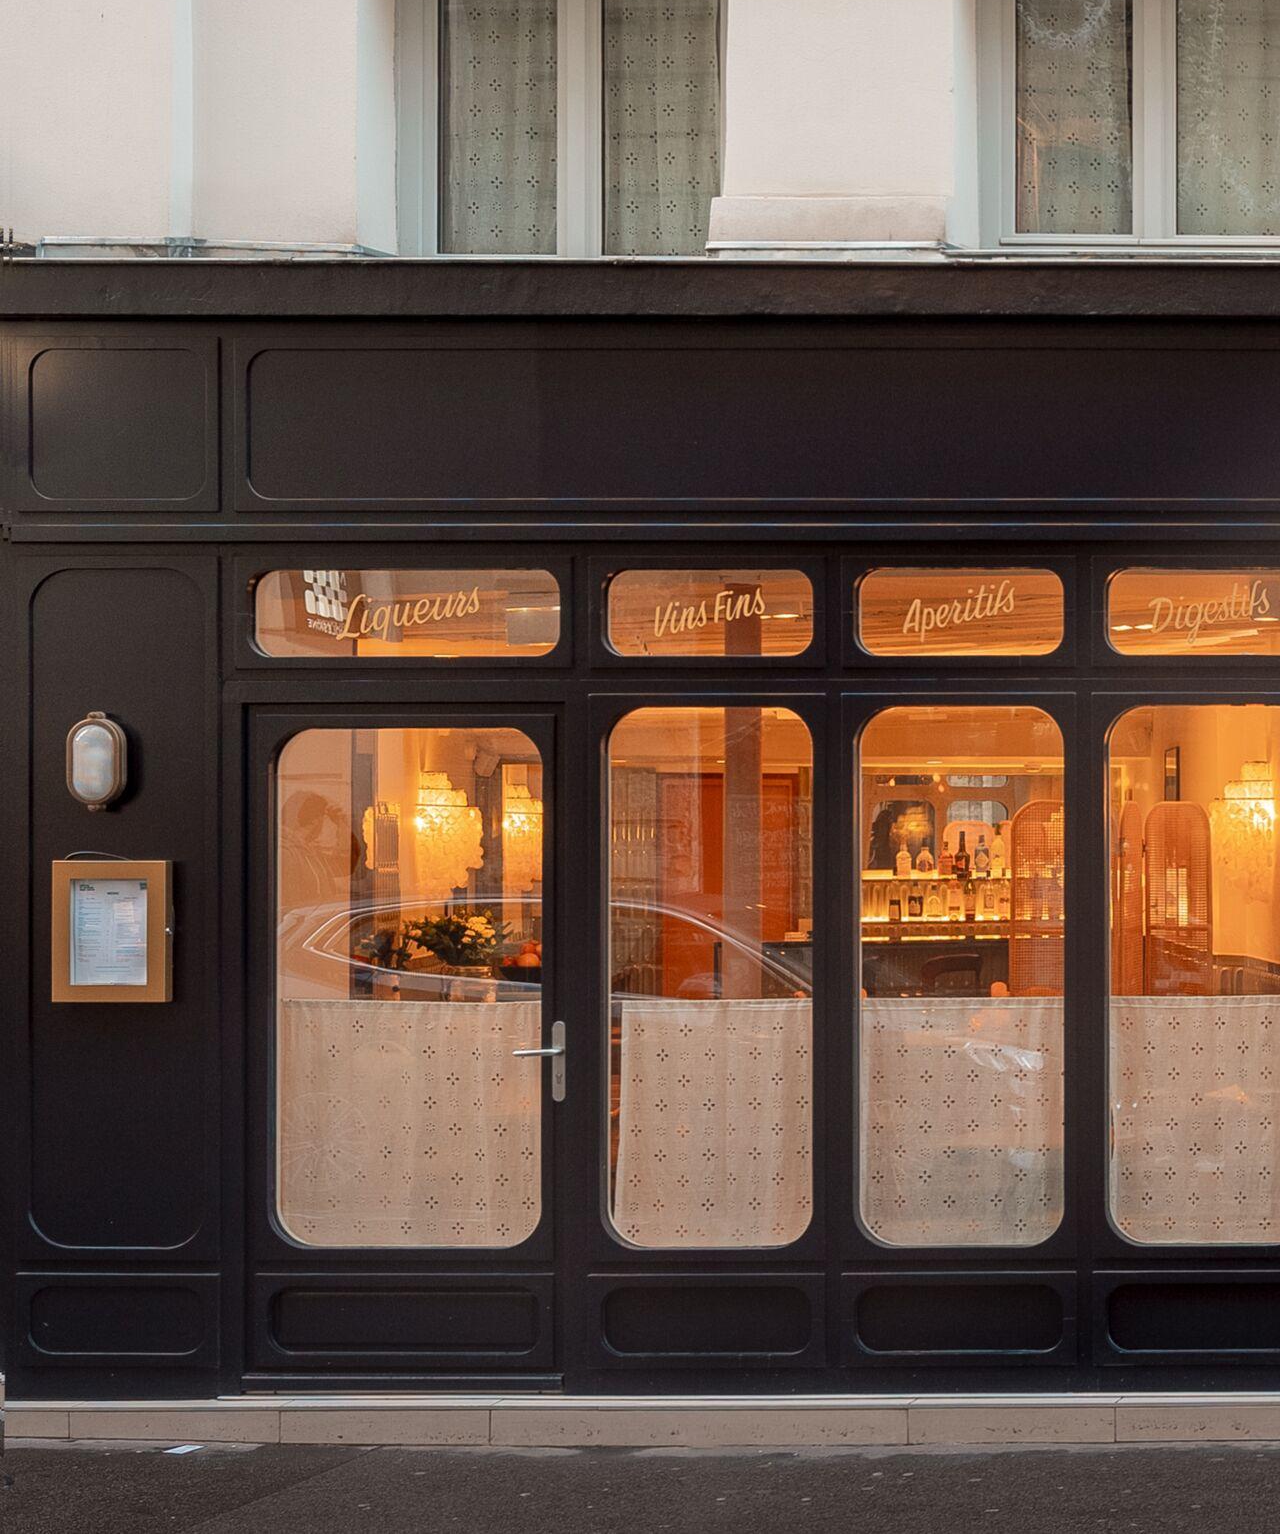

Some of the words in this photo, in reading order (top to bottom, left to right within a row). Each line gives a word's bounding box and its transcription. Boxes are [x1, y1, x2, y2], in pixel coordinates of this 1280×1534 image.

[336, 586, 481, 642] Liqueurs
[653, 599, 707, 638] Vins
[713, 586, 766, 626] Fins
[902, 579, 1015, 643] Aperitifs
[1148, 579, 1271, 643] Digestifs
